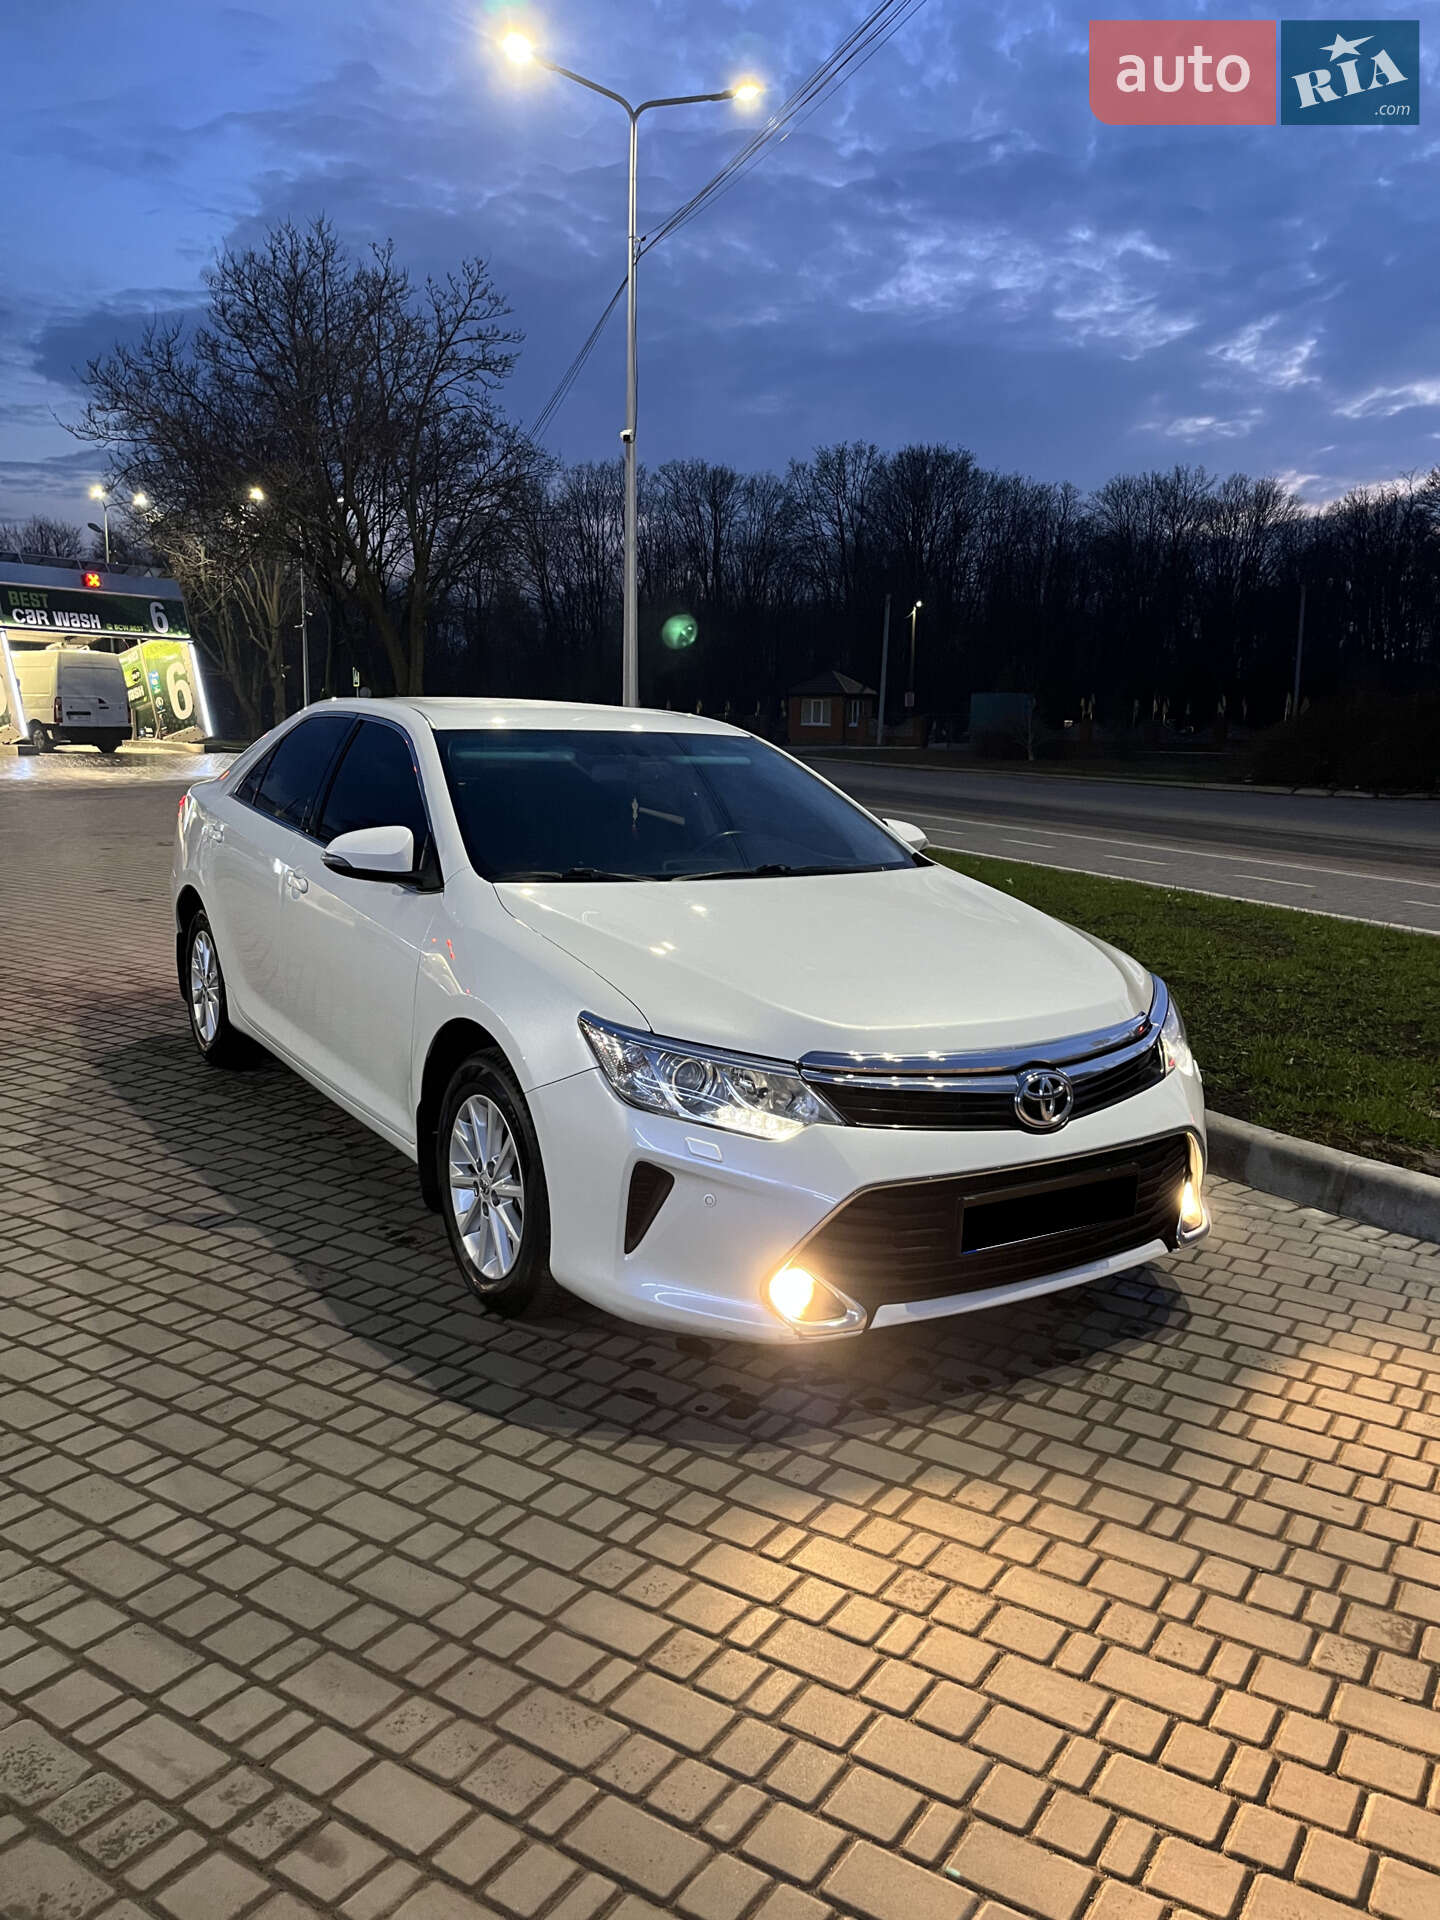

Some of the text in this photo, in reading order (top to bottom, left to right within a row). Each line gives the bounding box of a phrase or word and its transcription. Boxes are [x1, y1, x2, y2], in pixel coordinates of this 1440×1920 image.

[8, 590, 48, 608] BEST
[150, 601, 169, 634] 6
[166, 662, 194, 720] 6
